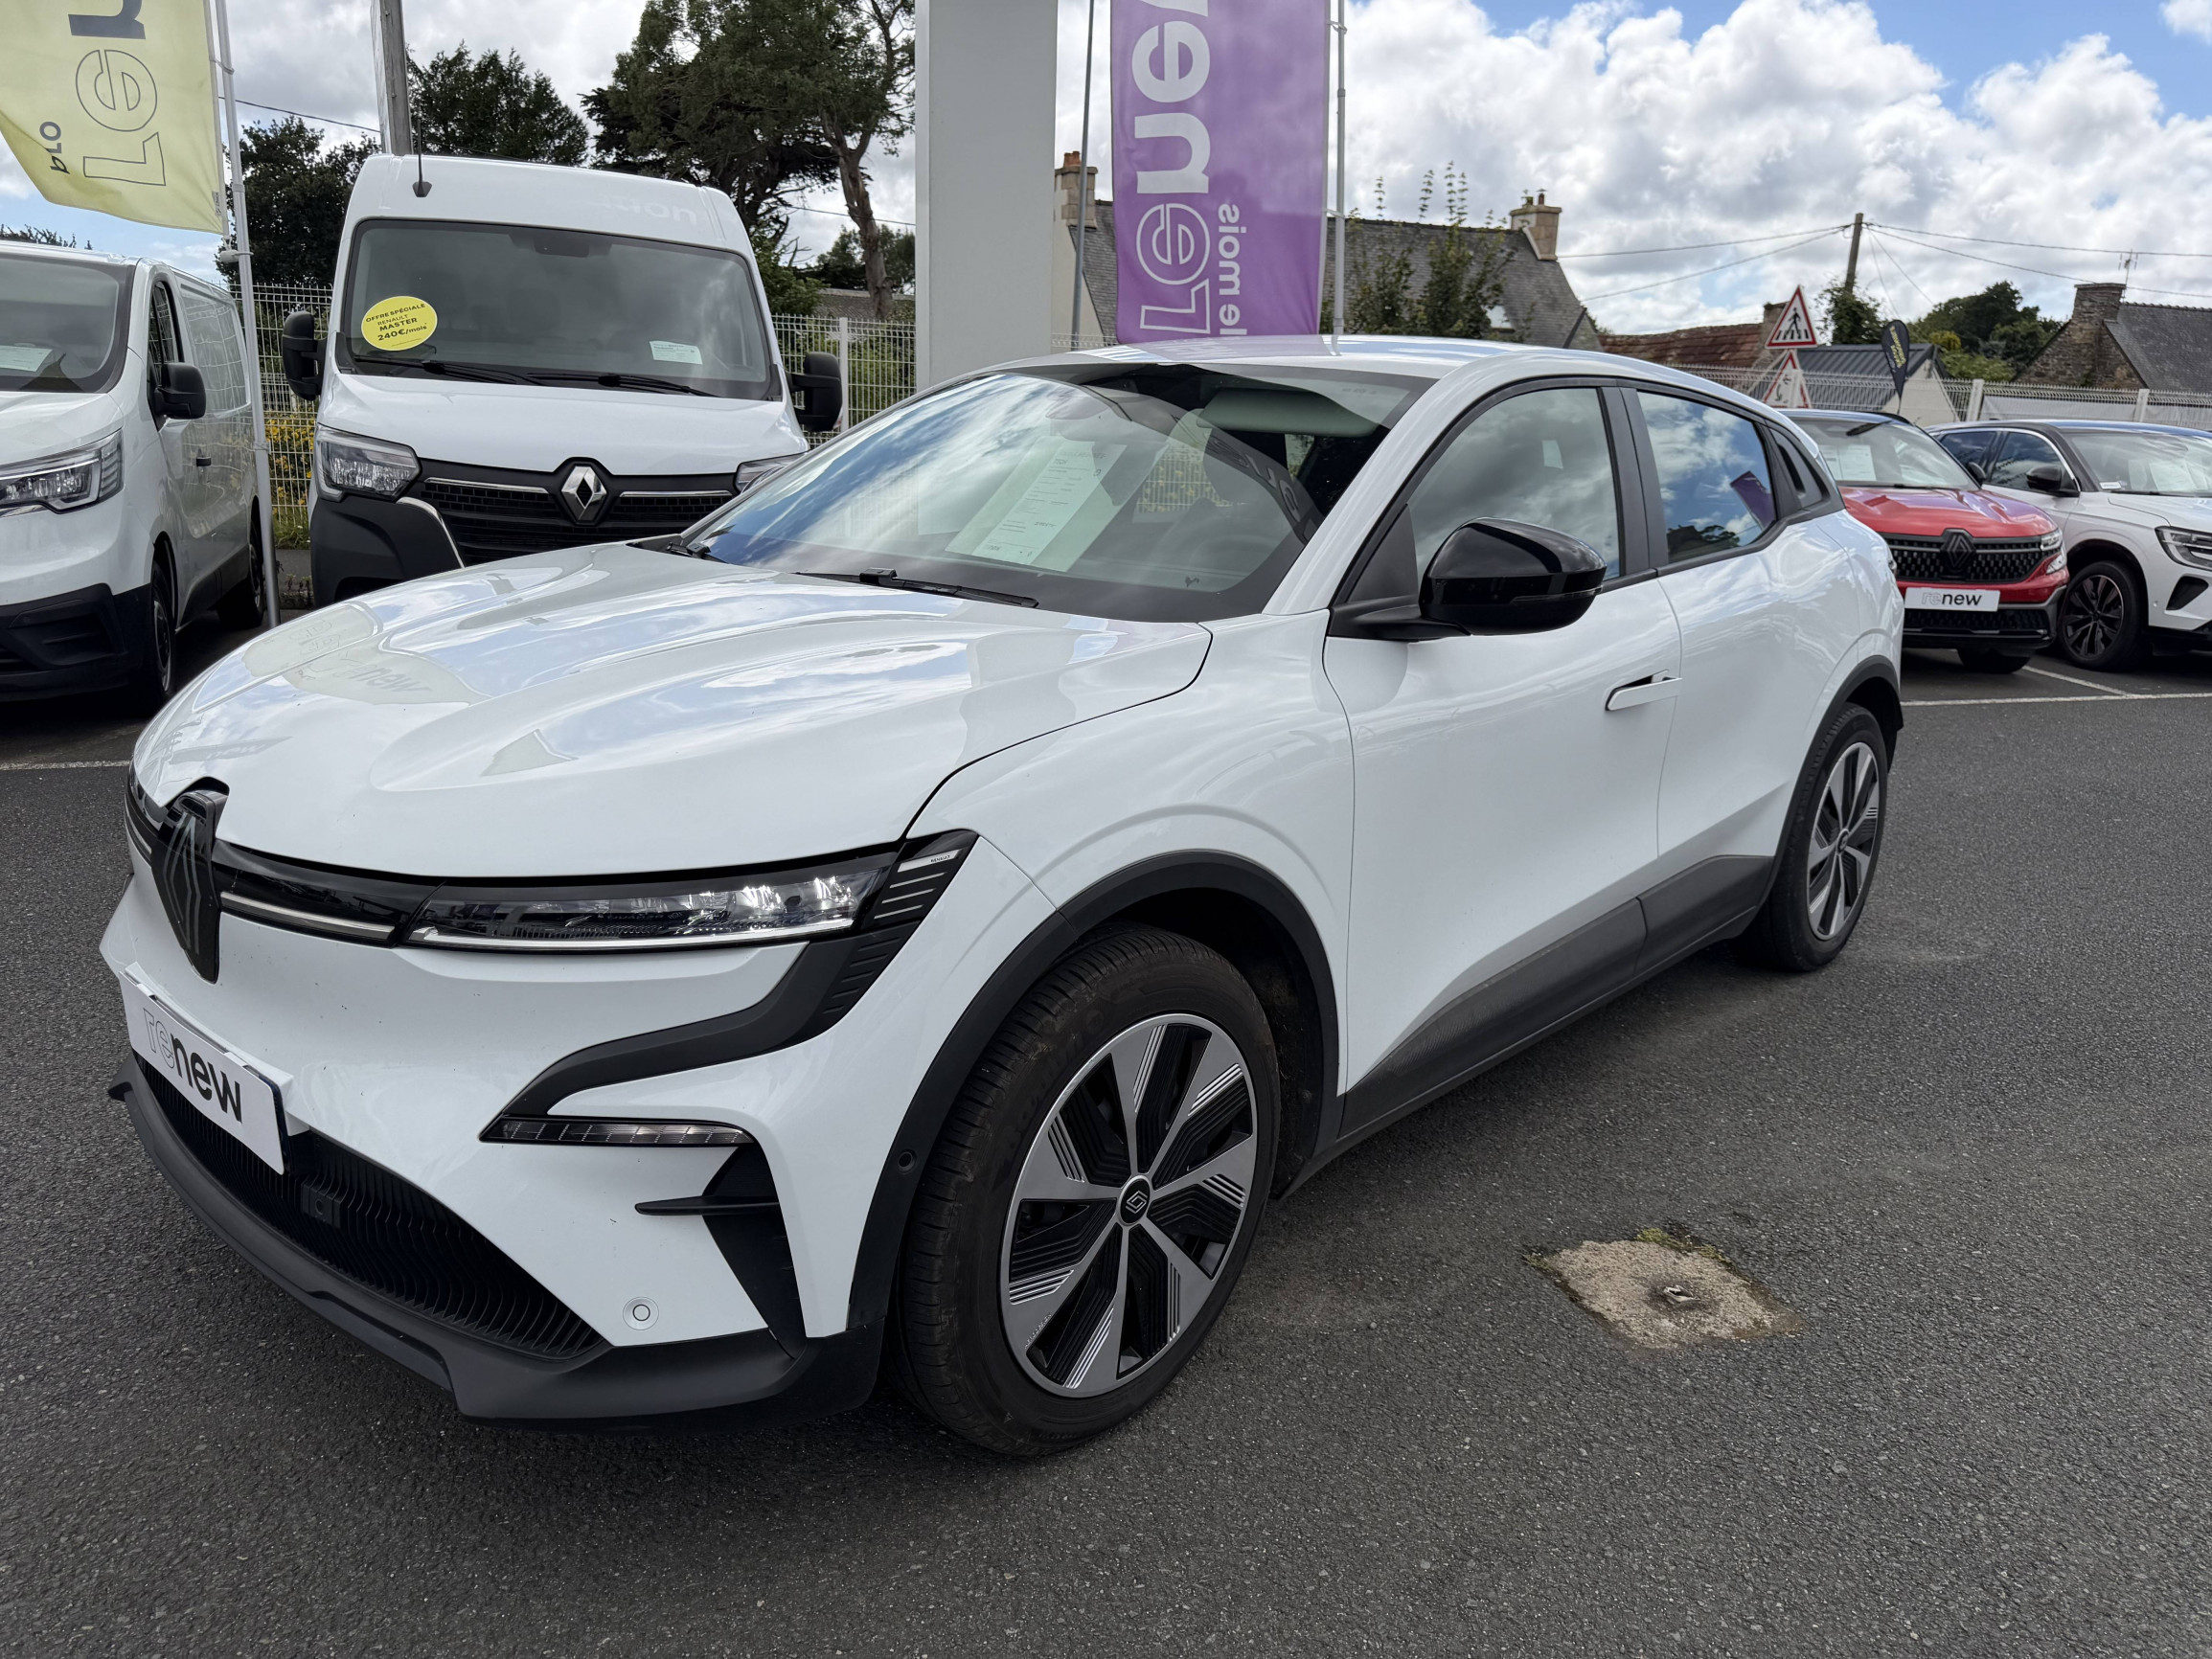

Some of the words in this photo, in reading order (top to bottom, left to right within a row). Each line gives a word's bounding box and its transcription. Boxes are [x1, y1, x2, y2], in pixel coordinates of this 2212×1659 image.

[365, 311, 390, 323] OFFRE
[390, 303, 426, 316] SPÉCIALE
[377, 314, 408, 326] RENAULT
[379, 317, 418, 331] MASTER
[1921, 592, 1982, 605] renew
[143, 1007, 242, 1125] renew
